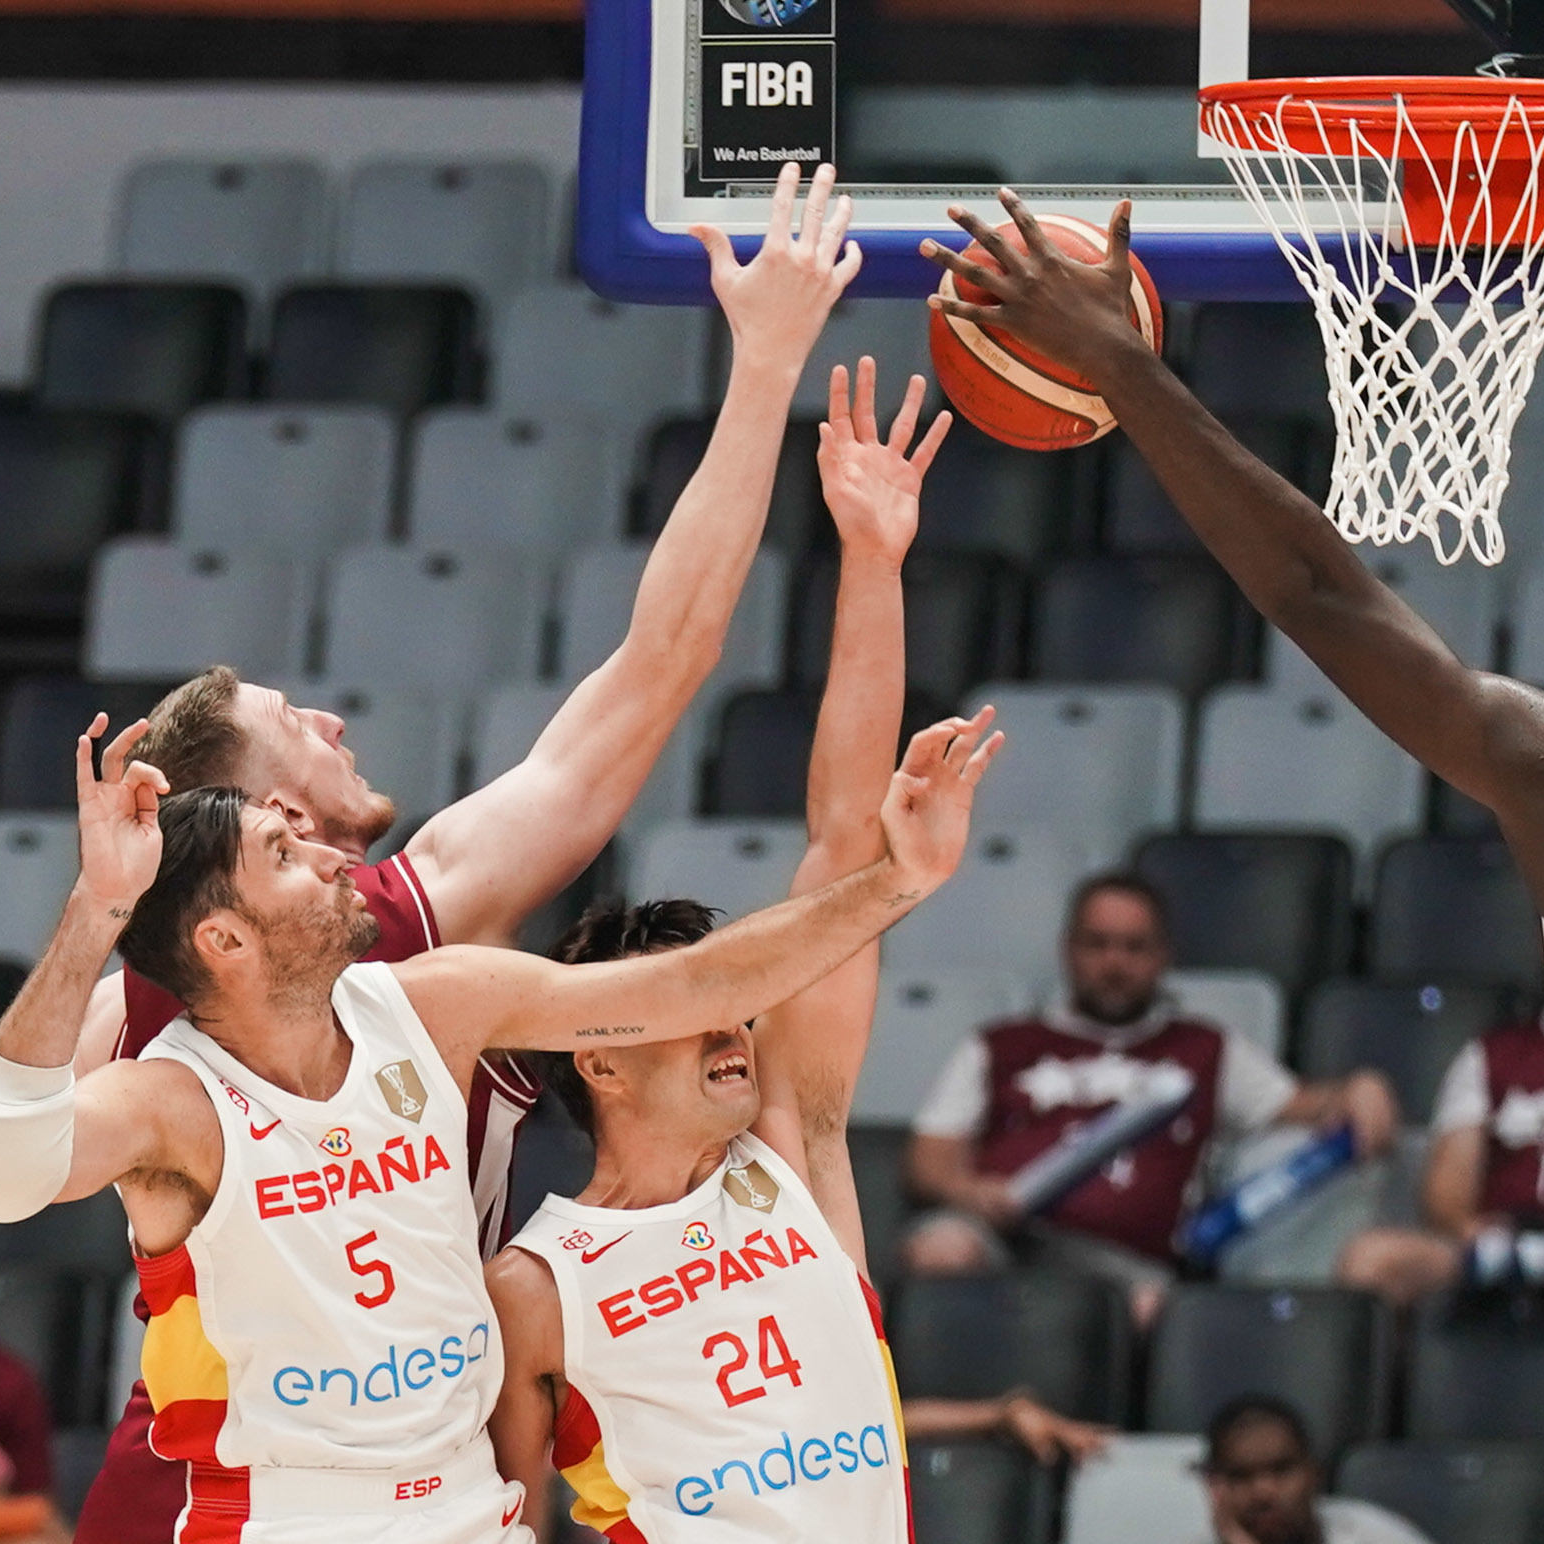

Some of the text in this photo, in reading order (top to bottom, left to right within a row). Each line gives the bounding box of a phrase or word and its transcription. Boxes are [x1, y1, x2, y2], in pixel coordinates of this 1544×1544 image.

[721, 61, 814, 107] FIBA
[713, 146, 822, 162] We Are Basketball
[255, 1134, 451, 1220] ESPAÑA
[345, 1229, 397, 1311] 5
[597, 1227, 819, 1339] ESPAÑA
[272, 1321, 490, 1408] endesa
[700, 1314, 802, 1410] 24
[394, 1475, 443, 1502] ESP
[674, 1423, 889, 1517] endesa
